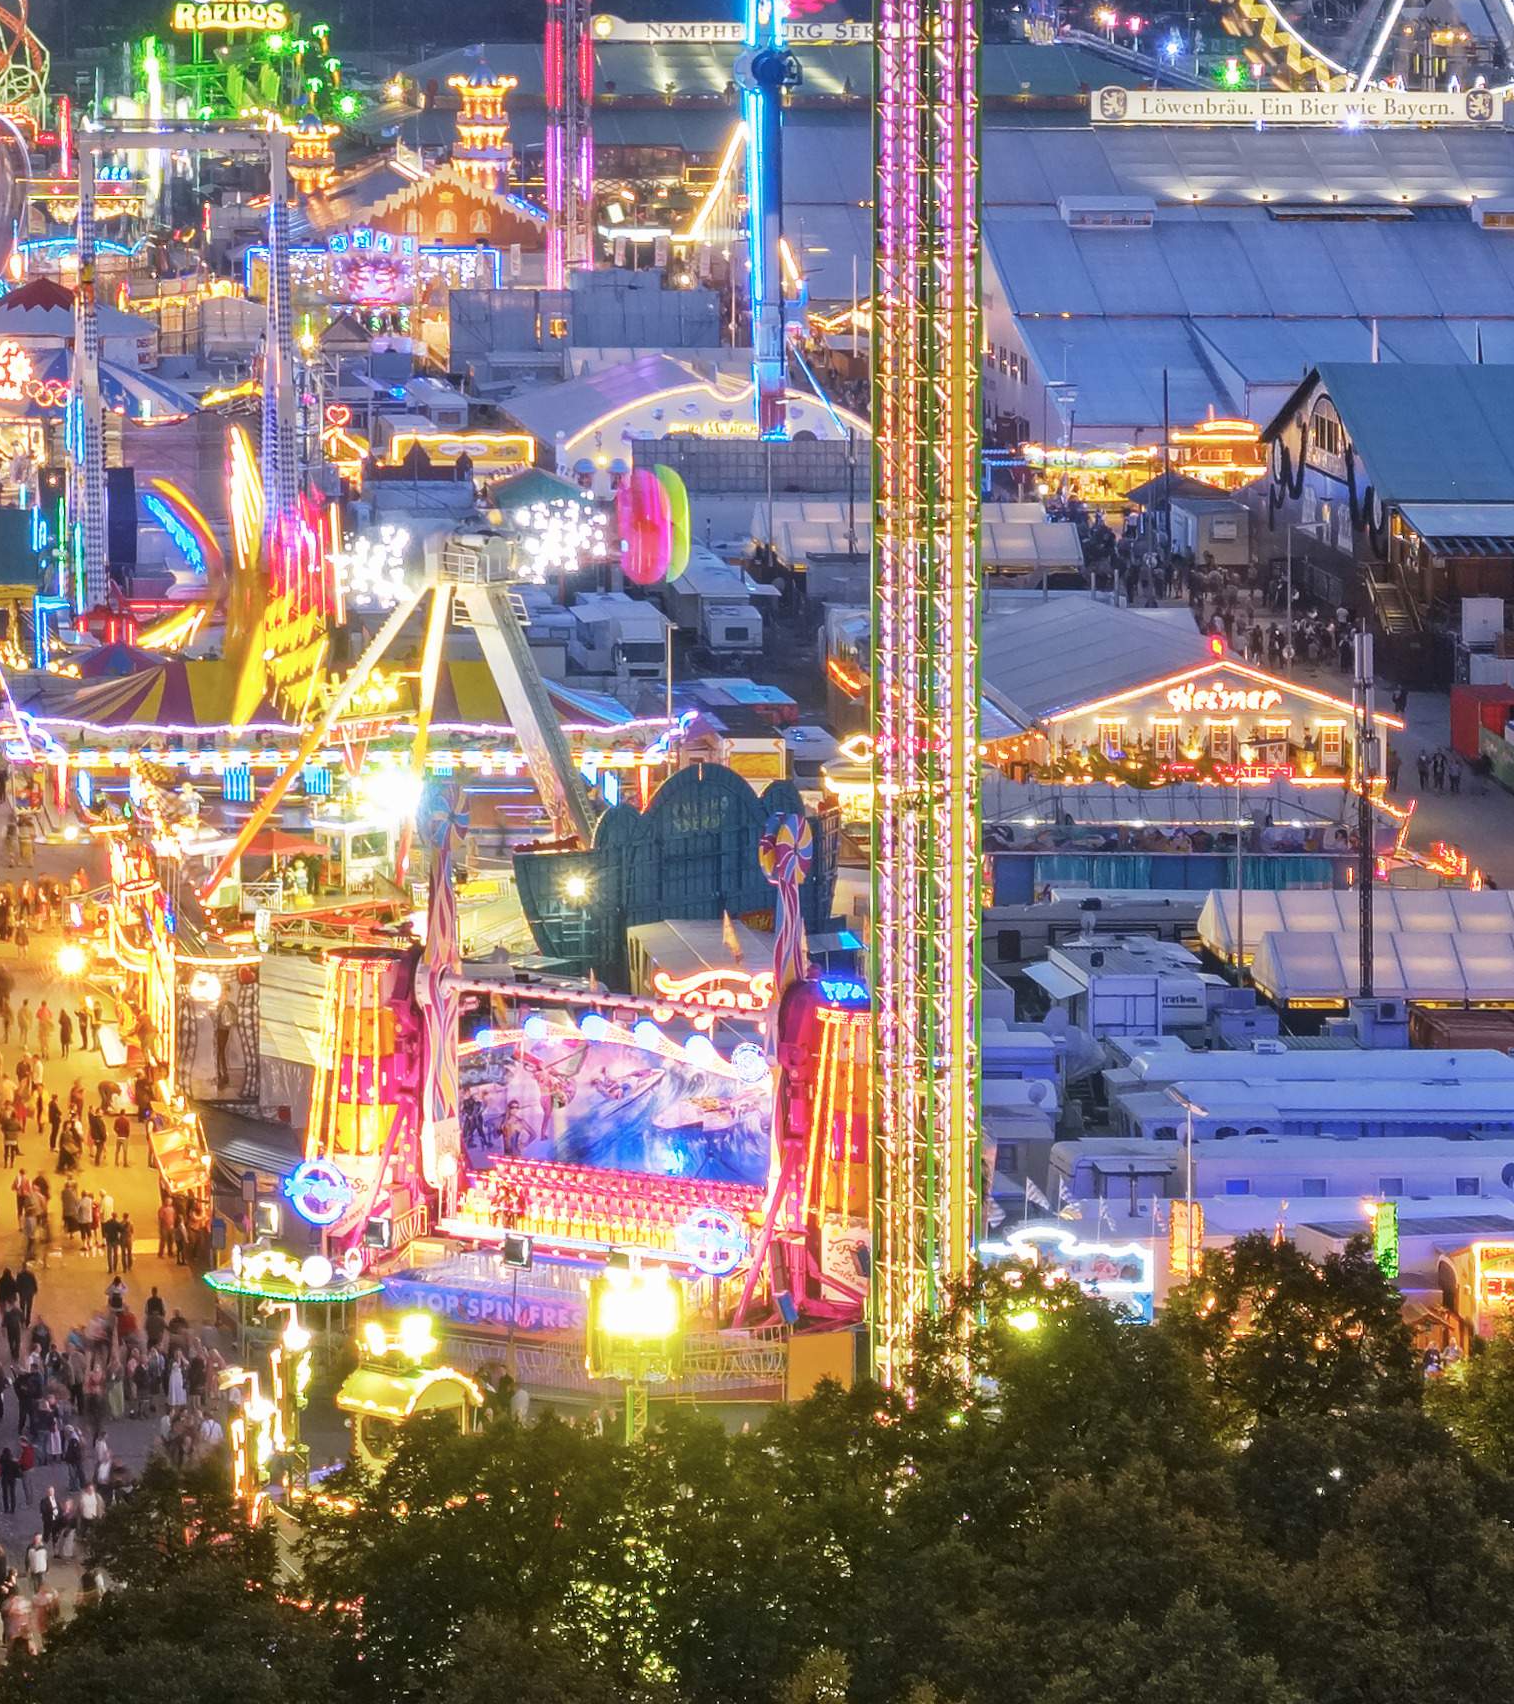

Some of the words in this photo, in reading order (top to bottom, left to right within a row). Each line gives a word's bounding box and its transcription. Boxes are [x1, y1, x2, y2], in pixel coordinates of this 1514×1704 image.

[834, 22, 878, 40] SEK
[1141, 97, 1253, 115] Löwenbräu.
[1260, 97, 1294, 115] Ein
[1301, 97, 1338, 115] Bier
[1346, 98, 1377, 115] wie
[1384, 97, 1455, 119] Bayern.
[414, 1289, 460, 1314] TOP
[467, 1297, 522, 1322] SPIN
[526, 1304, 587, 1329] FRES
